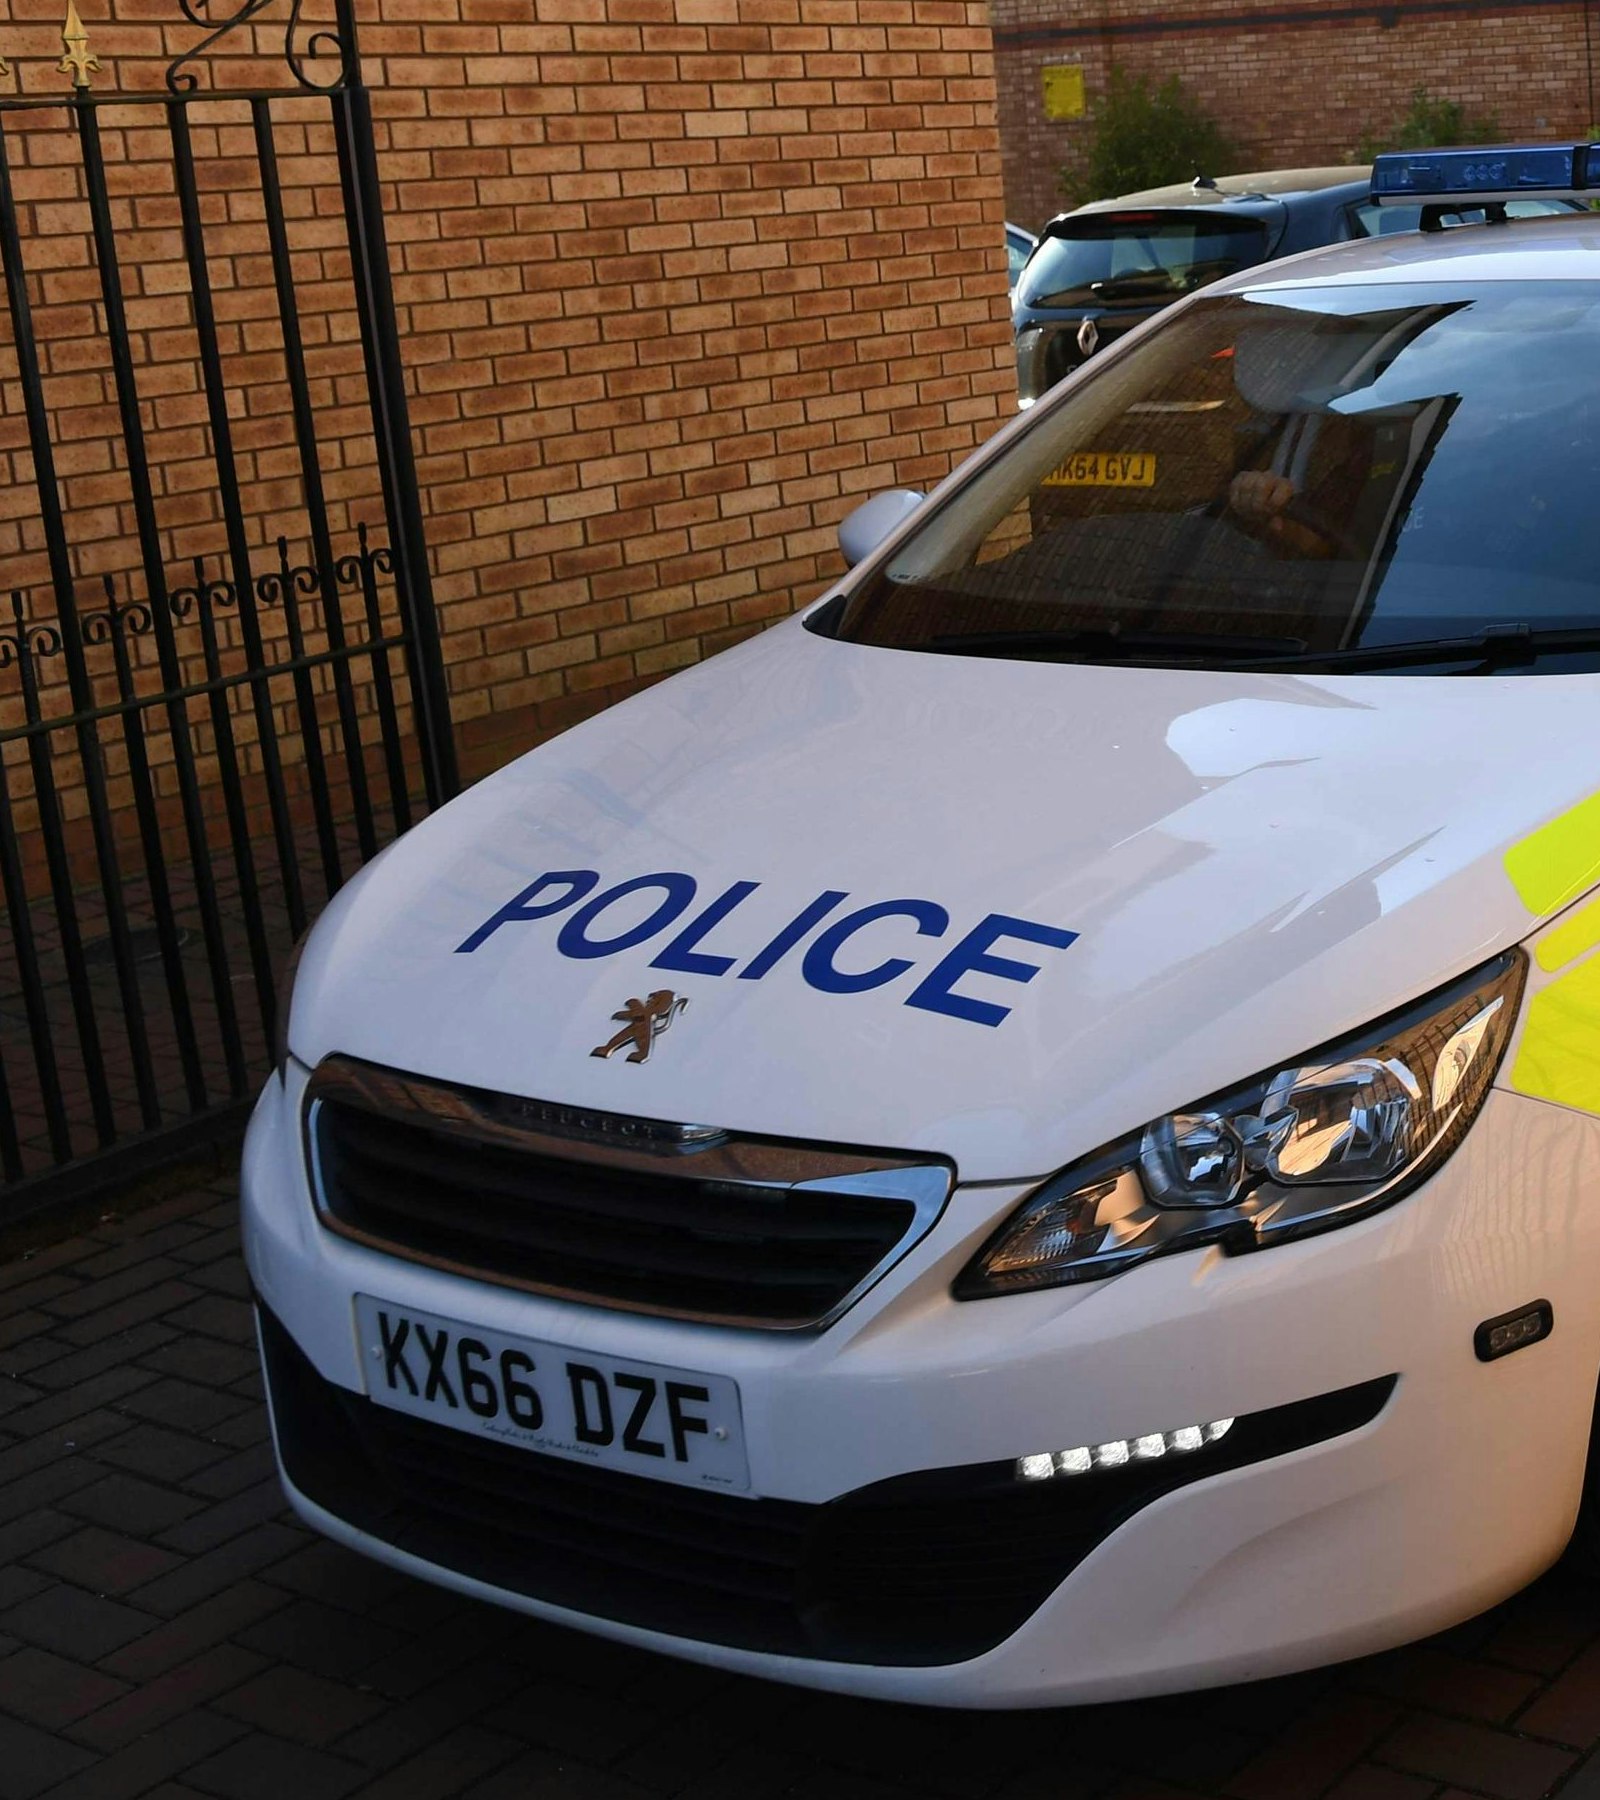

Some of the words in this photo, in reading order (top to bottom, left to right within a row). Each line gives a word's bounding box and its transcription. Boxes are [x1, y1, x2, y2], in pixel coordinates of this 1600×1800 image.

[1105, 457, 1146, 481] GVJ
[453, 870, 1081, 1028] POLICE
[378, 1311, 544, 1431] KX66
[565, 1361, 710, 1463] DZF
